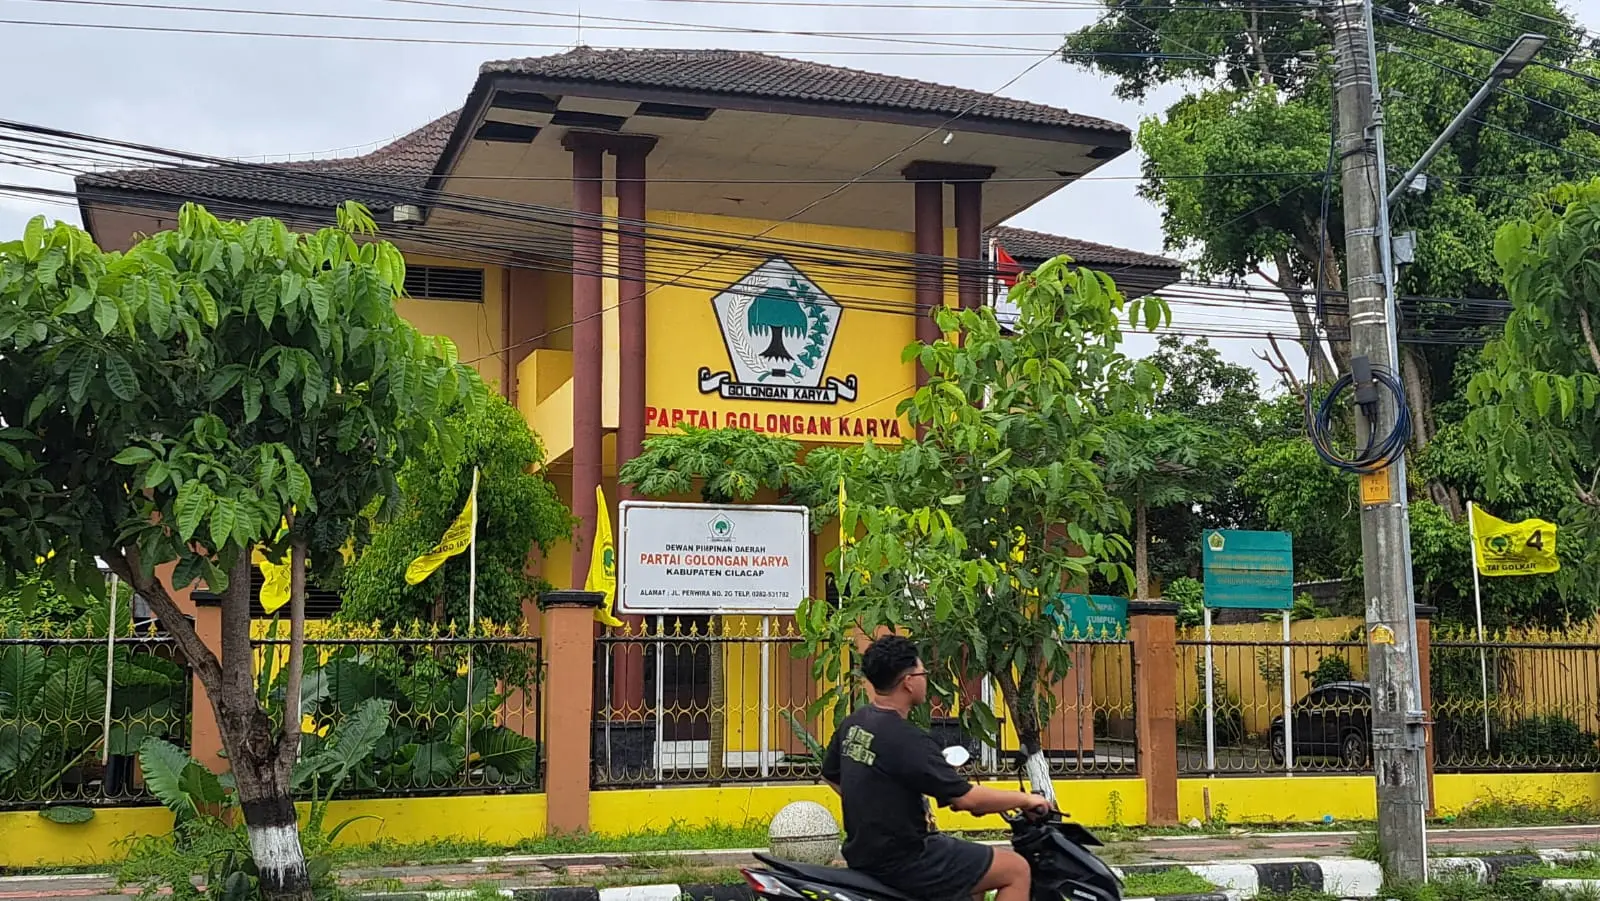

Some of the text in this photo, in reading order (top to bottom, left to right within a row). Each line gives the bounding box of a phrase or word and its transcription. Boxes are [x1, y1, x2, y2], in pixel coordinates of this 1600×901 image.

[728, 385, 830, 400] GOLONGAN KARYA
[645, 406, 901, 438] PARTAI GOLONGAN KARYA
[665, 543, 766, 553] DEWAN PIMPINAN DAERAH
[1526, 529, 1544, 552] 4
[639, 553, 789, 568] PARTAI GOLONGAN KARYA
[666, 568, 765, 577] KABUPATEN CILACAP
